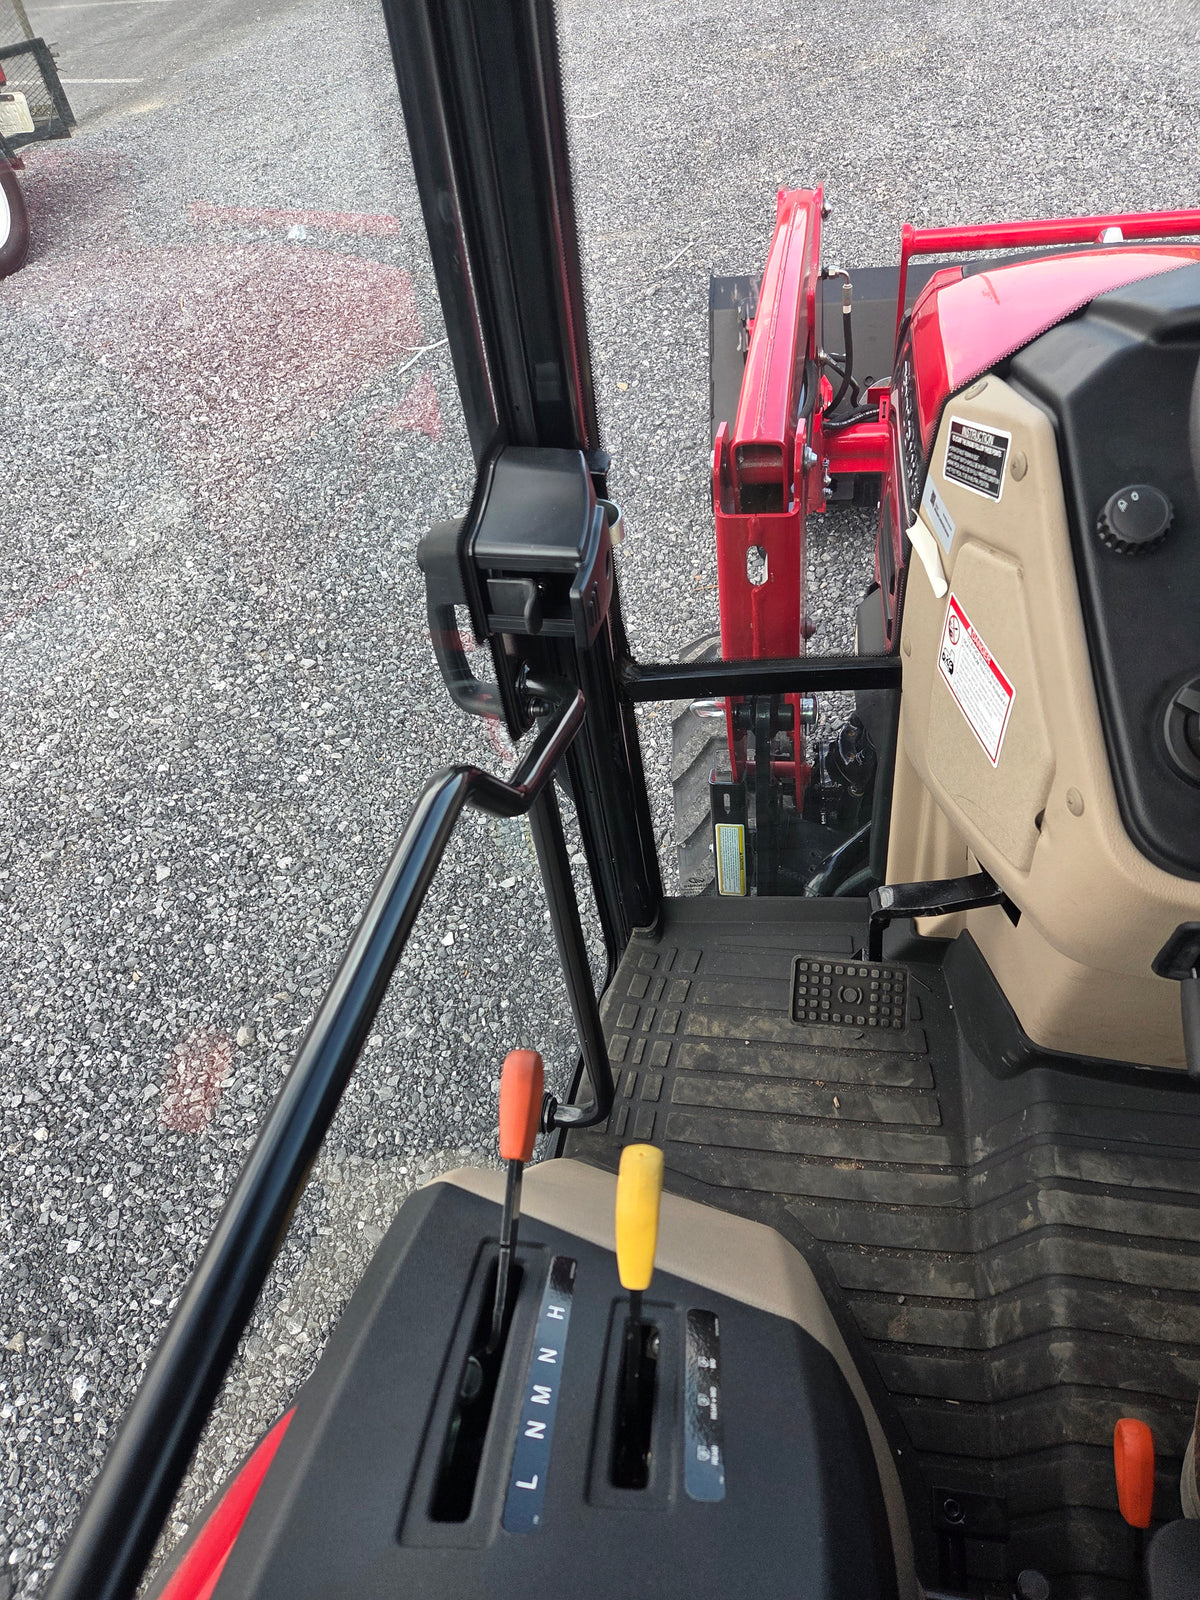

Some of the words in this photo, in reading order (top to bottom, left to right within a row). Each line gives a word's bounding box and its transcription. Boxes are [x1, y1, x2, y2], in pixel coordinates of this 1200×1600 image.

[547, 1304, 566, 1320] H
[537, 1347, 558, 1363] N
[530, 1385, 552, 1404] M
[524, 1420, 547, 1439] N
[515, 1474, 538, 1490] L
